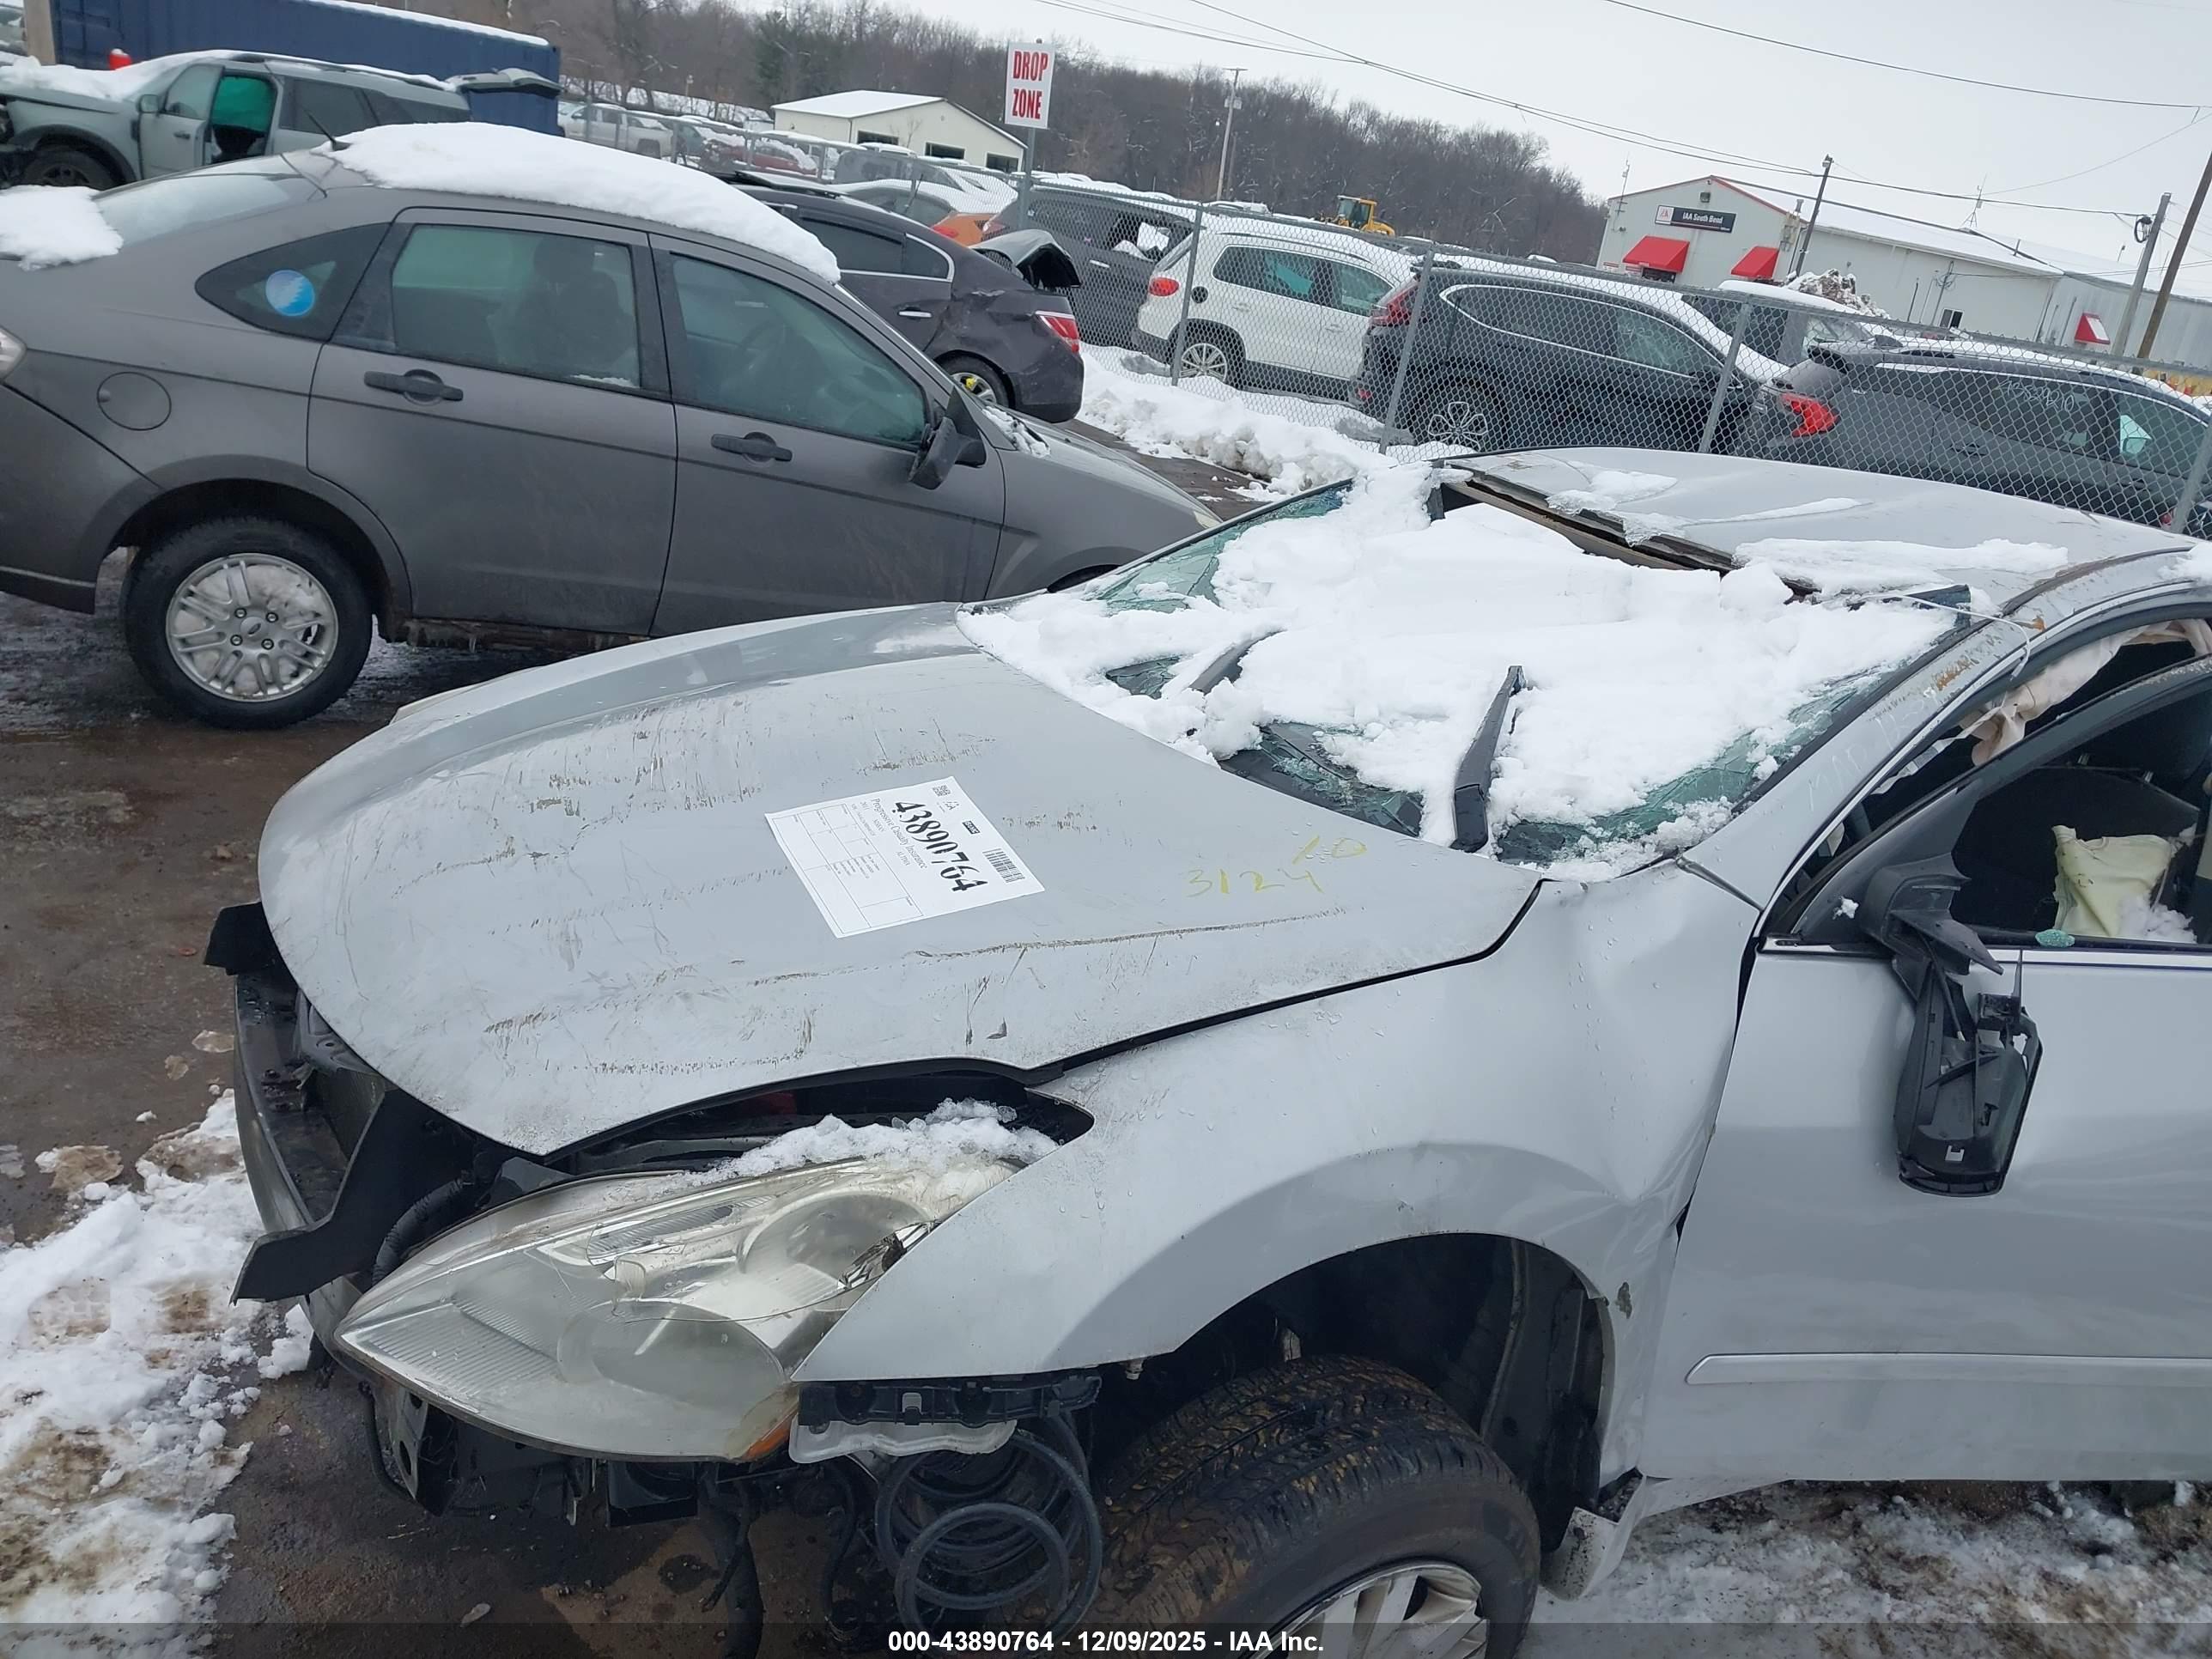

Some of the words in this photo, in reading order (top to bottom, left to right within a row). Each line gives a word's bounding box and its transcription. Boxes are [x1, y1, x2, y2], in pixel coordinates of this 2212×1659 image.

[1013, 50, 1048, 82] DROP
[1012, 88, 1042, 119] ZONE
[1683, 211, 1692, 221] IAA
[1692, 213, 1709, 222] South
[1709, 215, 1723, 224] Bend
[871, 798, 896, 826] Progressive
[890, 825, 908, 846] Casualty
[905, 845, 927, 869] Insurance
[892, 801, 988, 892] 43890764
